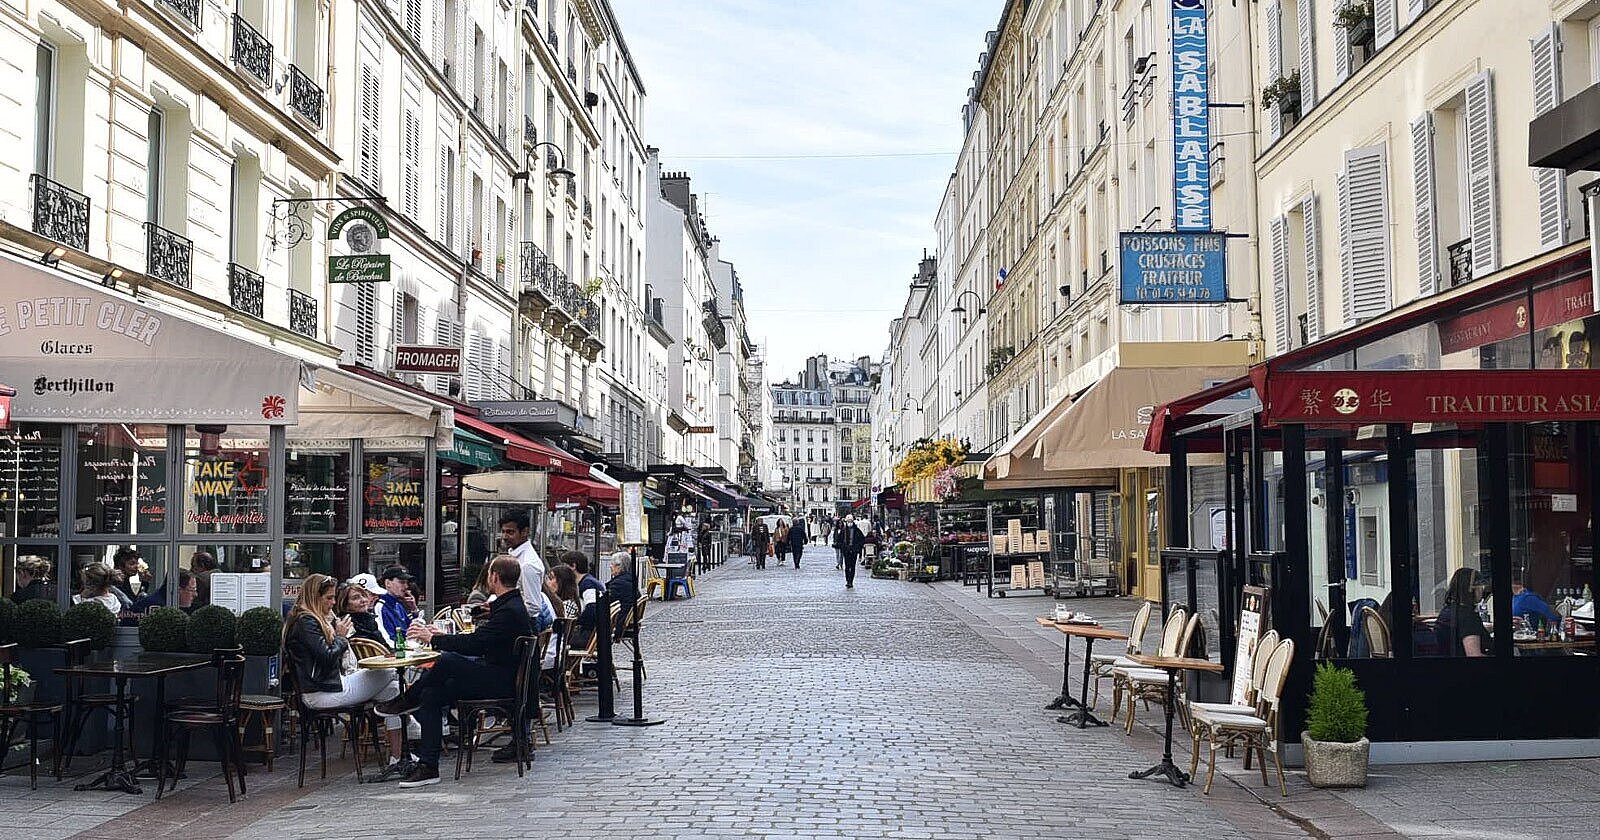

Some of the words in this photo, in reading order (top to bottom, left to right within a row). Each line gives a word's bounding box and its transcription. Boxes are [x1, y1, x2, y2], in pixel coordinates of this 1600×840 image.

[1174, 17, 1204, 34] LA
[1178, 51, 1205, 228] SABLAISE
[332, 219, 345, 234] VINS
[1122, 236, 1186, 252] POISSONS
[1193, 236, 1220, 252] FINS
[335, 257, 351, 270] Le
[334, 272, 345, 281] de
[1141, 270, 1204, 286] TRAITEUR
[16, 297, 91, 329] PETIT
[96, 301, 161, 346] CLER
[40, 340, 93, 355] Glaces
[396, 352, 460, 368] FROMAGER
[34, 375, 115, 397] Berthillon
[1300, 388, 1323, 415] 繁
[1368, 389, 1393, 415] 华
[1426, 395, 1549, 413] TRAITEUR
[1111, 429, 1128, 440] LA
[194, 461, 235, 479] TAKE
[192, 480, 235, 497] AWAY
